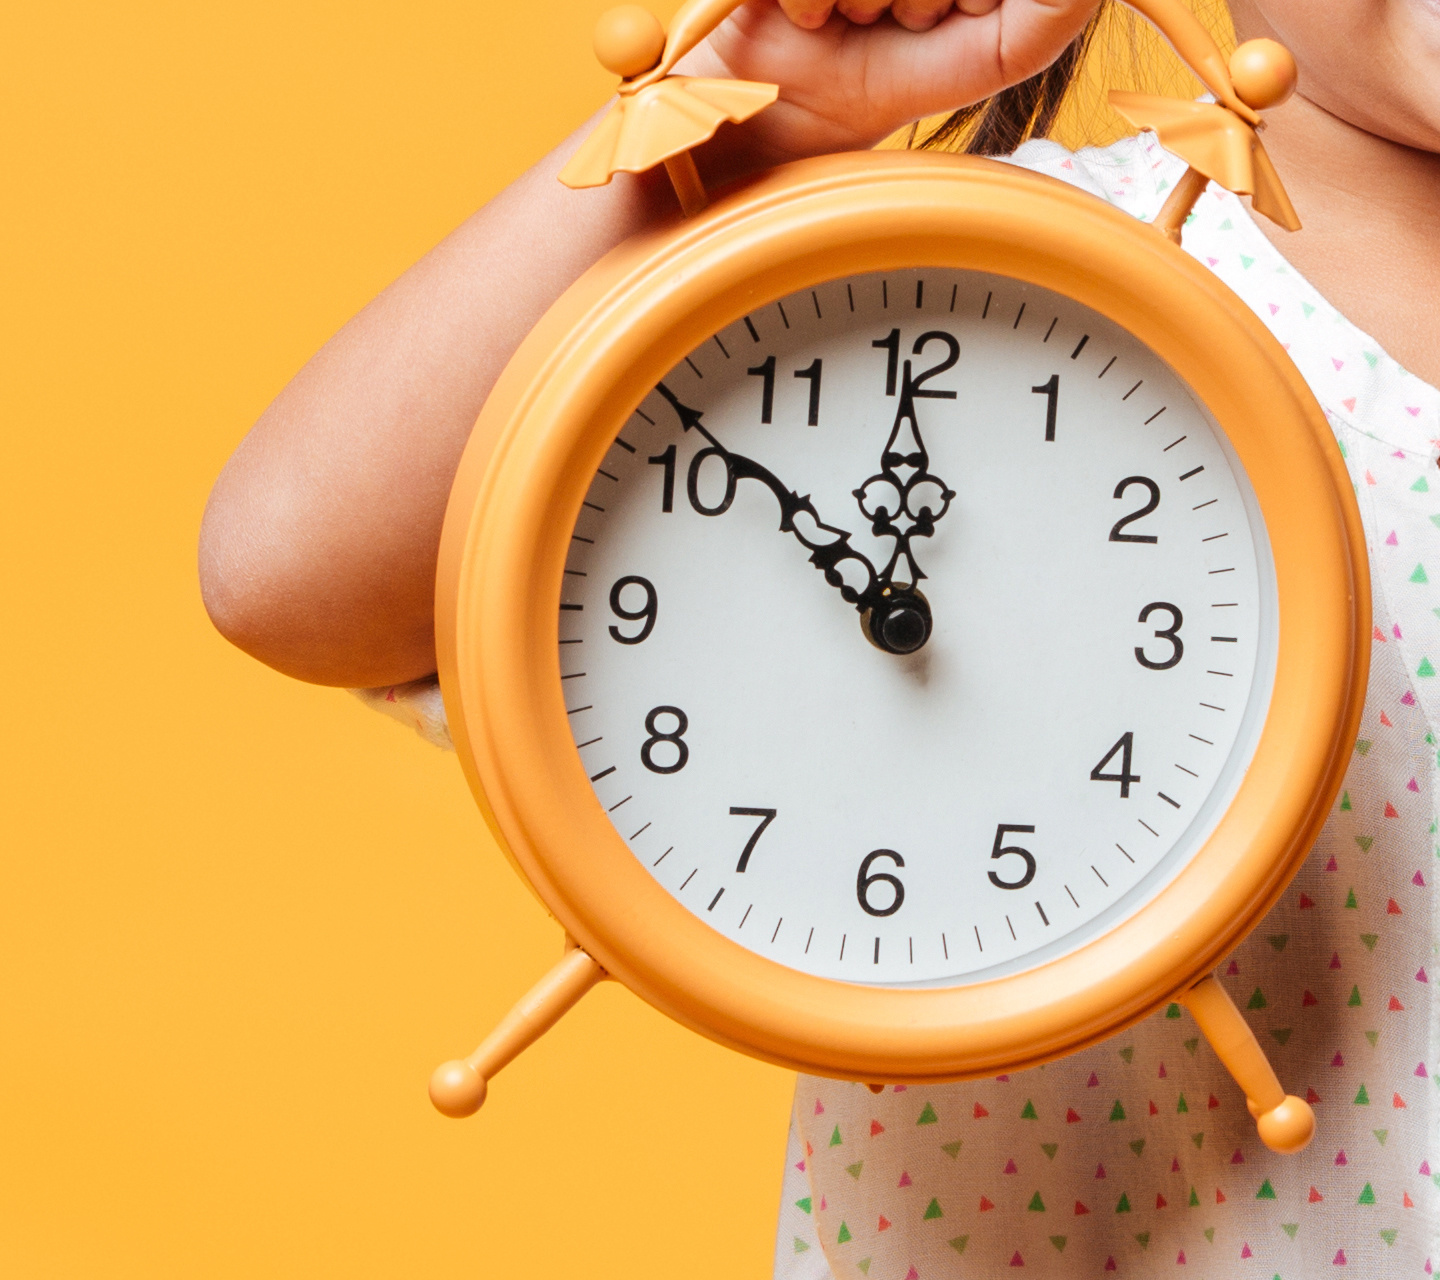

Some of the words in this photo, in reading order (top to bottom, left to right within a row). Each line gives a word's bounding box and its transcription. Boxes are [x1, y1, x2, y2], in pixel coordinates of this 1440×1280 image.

[747, 355, 823, 427] 11
[871, 328, 961, 400] 12
[1031, 374, 1060, 442] 1
[647, 444, 738, 517] 10
[1109, 476, 1161, 544] 2
[608, 575, 658, 645] 9
[1134, 601, 1184, 671] 3
[640, 705, 689, 775] 8
[1090, 731, 1141, 798] 4
[729, 806, 777, 873] 7
[987, 823, 1037, 890] 5
[856, 848, 905, 917] 6
